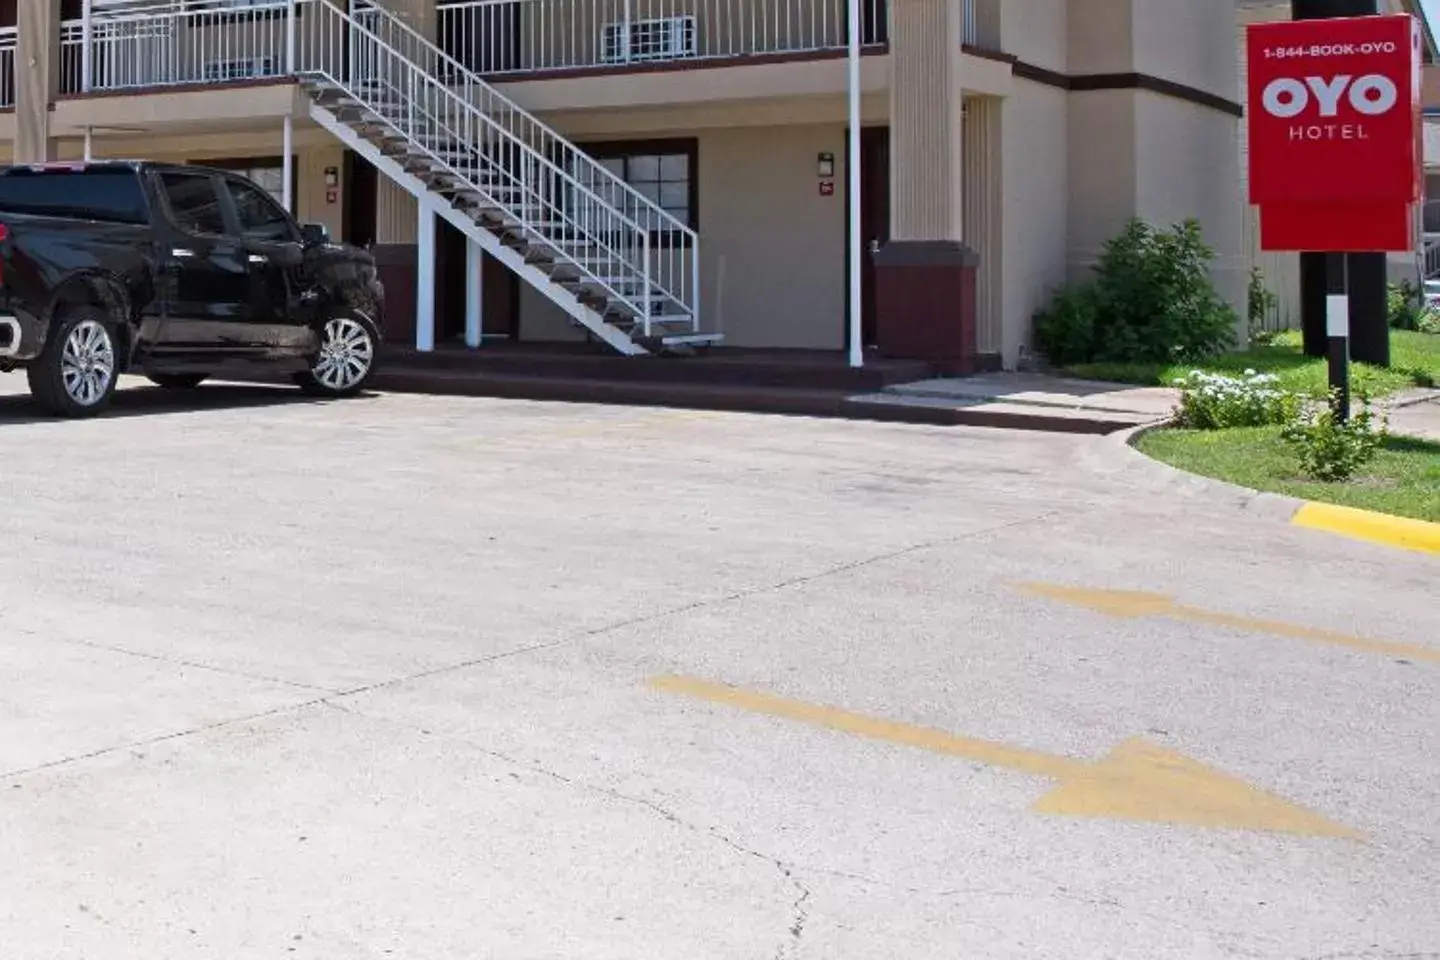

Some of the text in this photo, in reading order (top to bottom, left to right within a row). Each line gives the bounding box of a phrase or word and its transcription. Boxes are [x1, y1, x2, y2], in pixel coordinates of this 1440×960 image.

[1263, 42, 1396, 58] 1-844-BOOK-OYO
[1262, 74, 1397, 117] OYO
[1289, 124, 1368, 140] HOTEL
